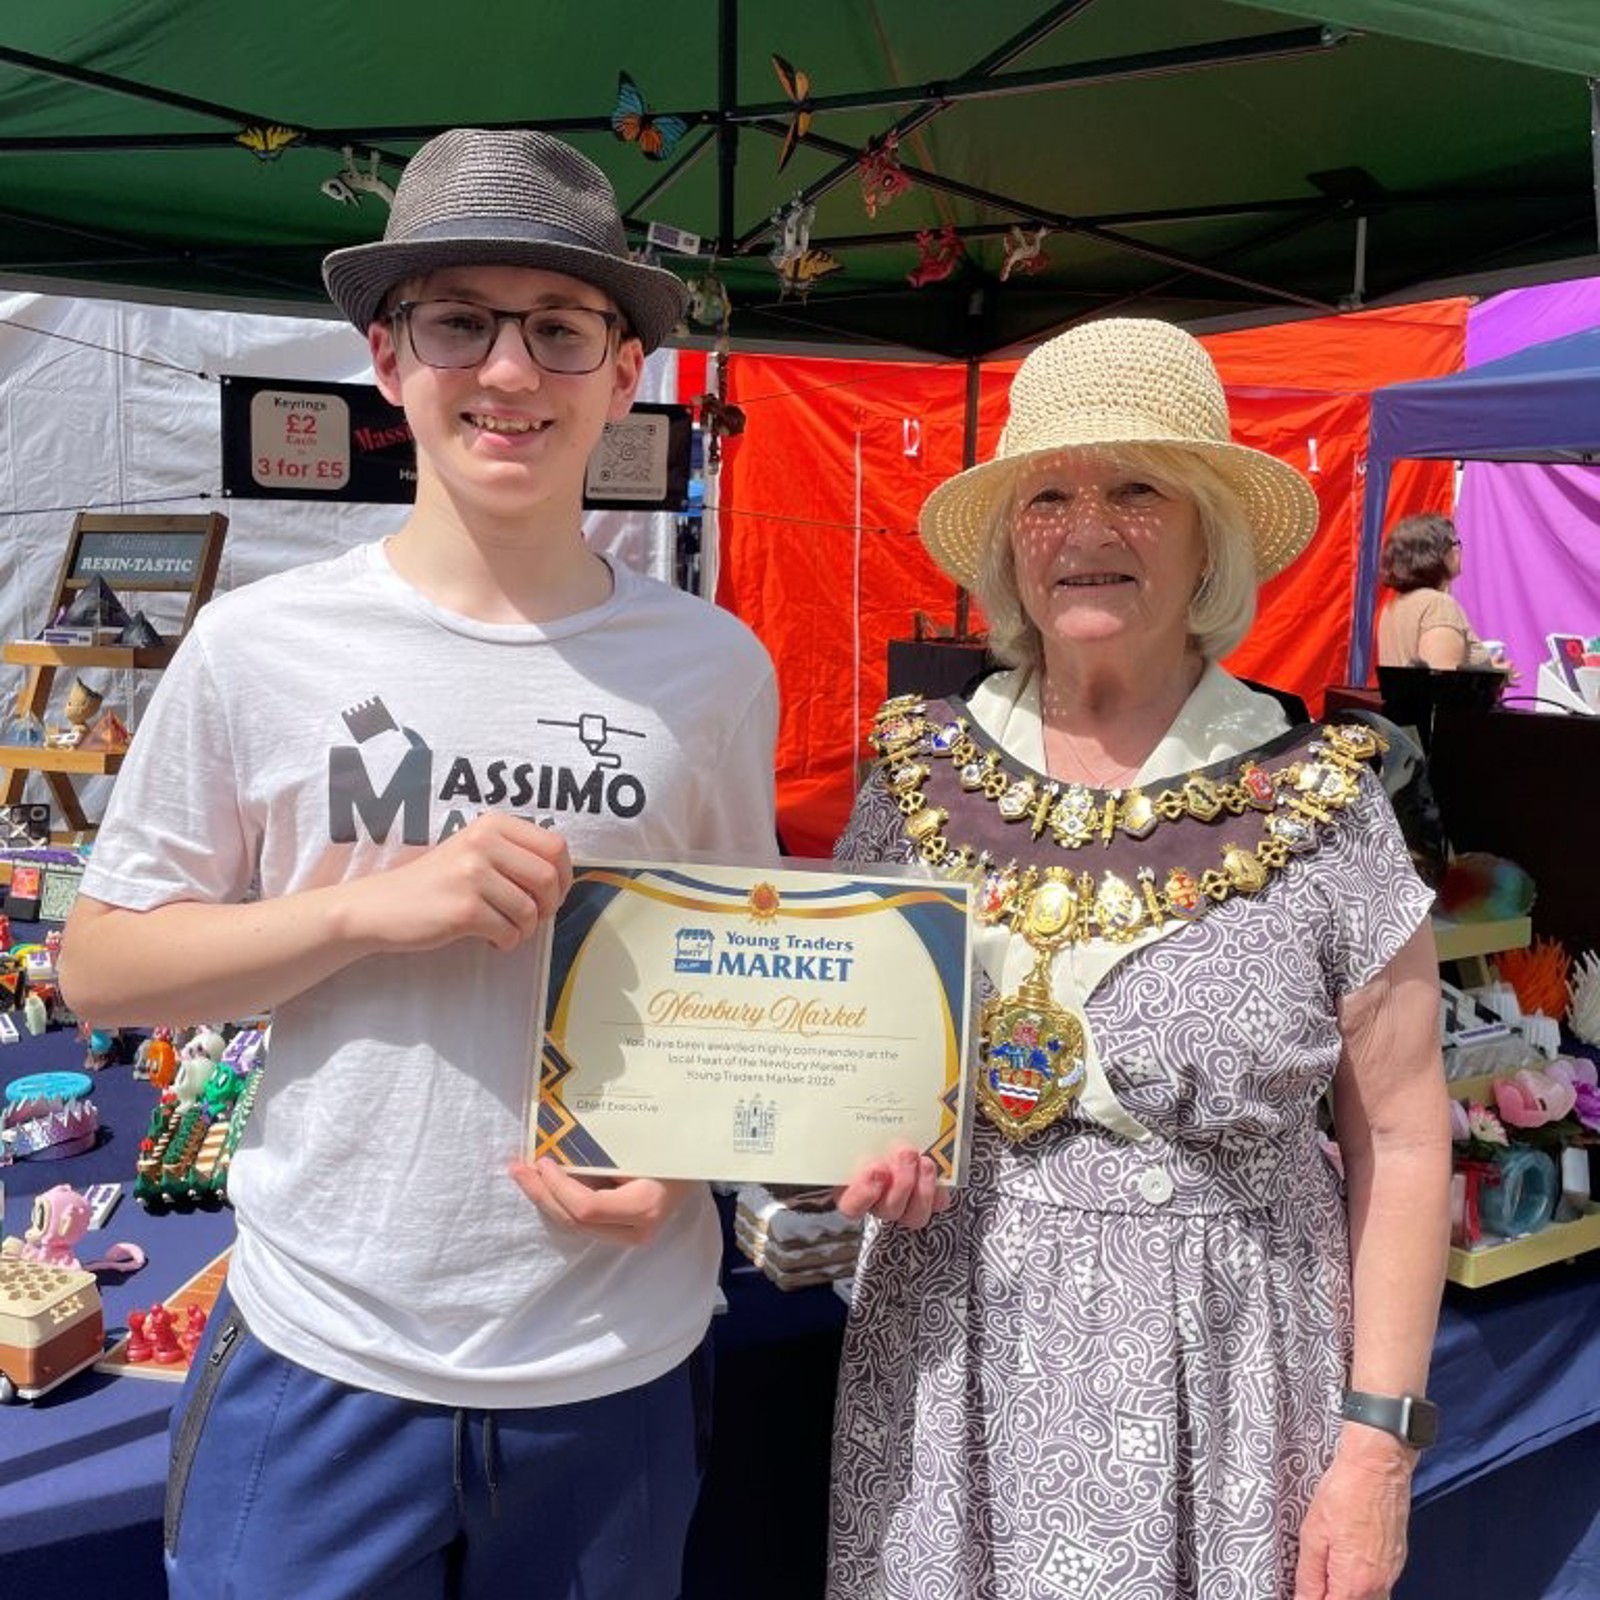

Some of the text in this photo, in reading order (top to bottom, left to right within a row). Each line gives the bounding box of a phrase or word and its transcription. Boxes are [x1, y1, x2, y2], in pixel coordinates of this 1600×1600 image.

[274, 396, 328, 411] Keyrings
[286, 413, 317, 435] £2
[257, 457, 344, 479] 3 for £5
[80, 557, 193, 572] RESIN-TASTIC
[726, 931, 854, 952] Young Traders
[716, 951, 855, 982] MARKET
[647, 988, 868, 1037] Newbury Market
[676, 1040, 705, 1051] been
[707, 1041, 756, 1053] awarded
[759, 1058, 809, 1071] Newbury
[723, 1071, 764, 1082] Traders
[766, 1073, 805, 1084] Market
[607, 1101, 659, 1113] Executive
[855, 1112, 904, 1124] President
